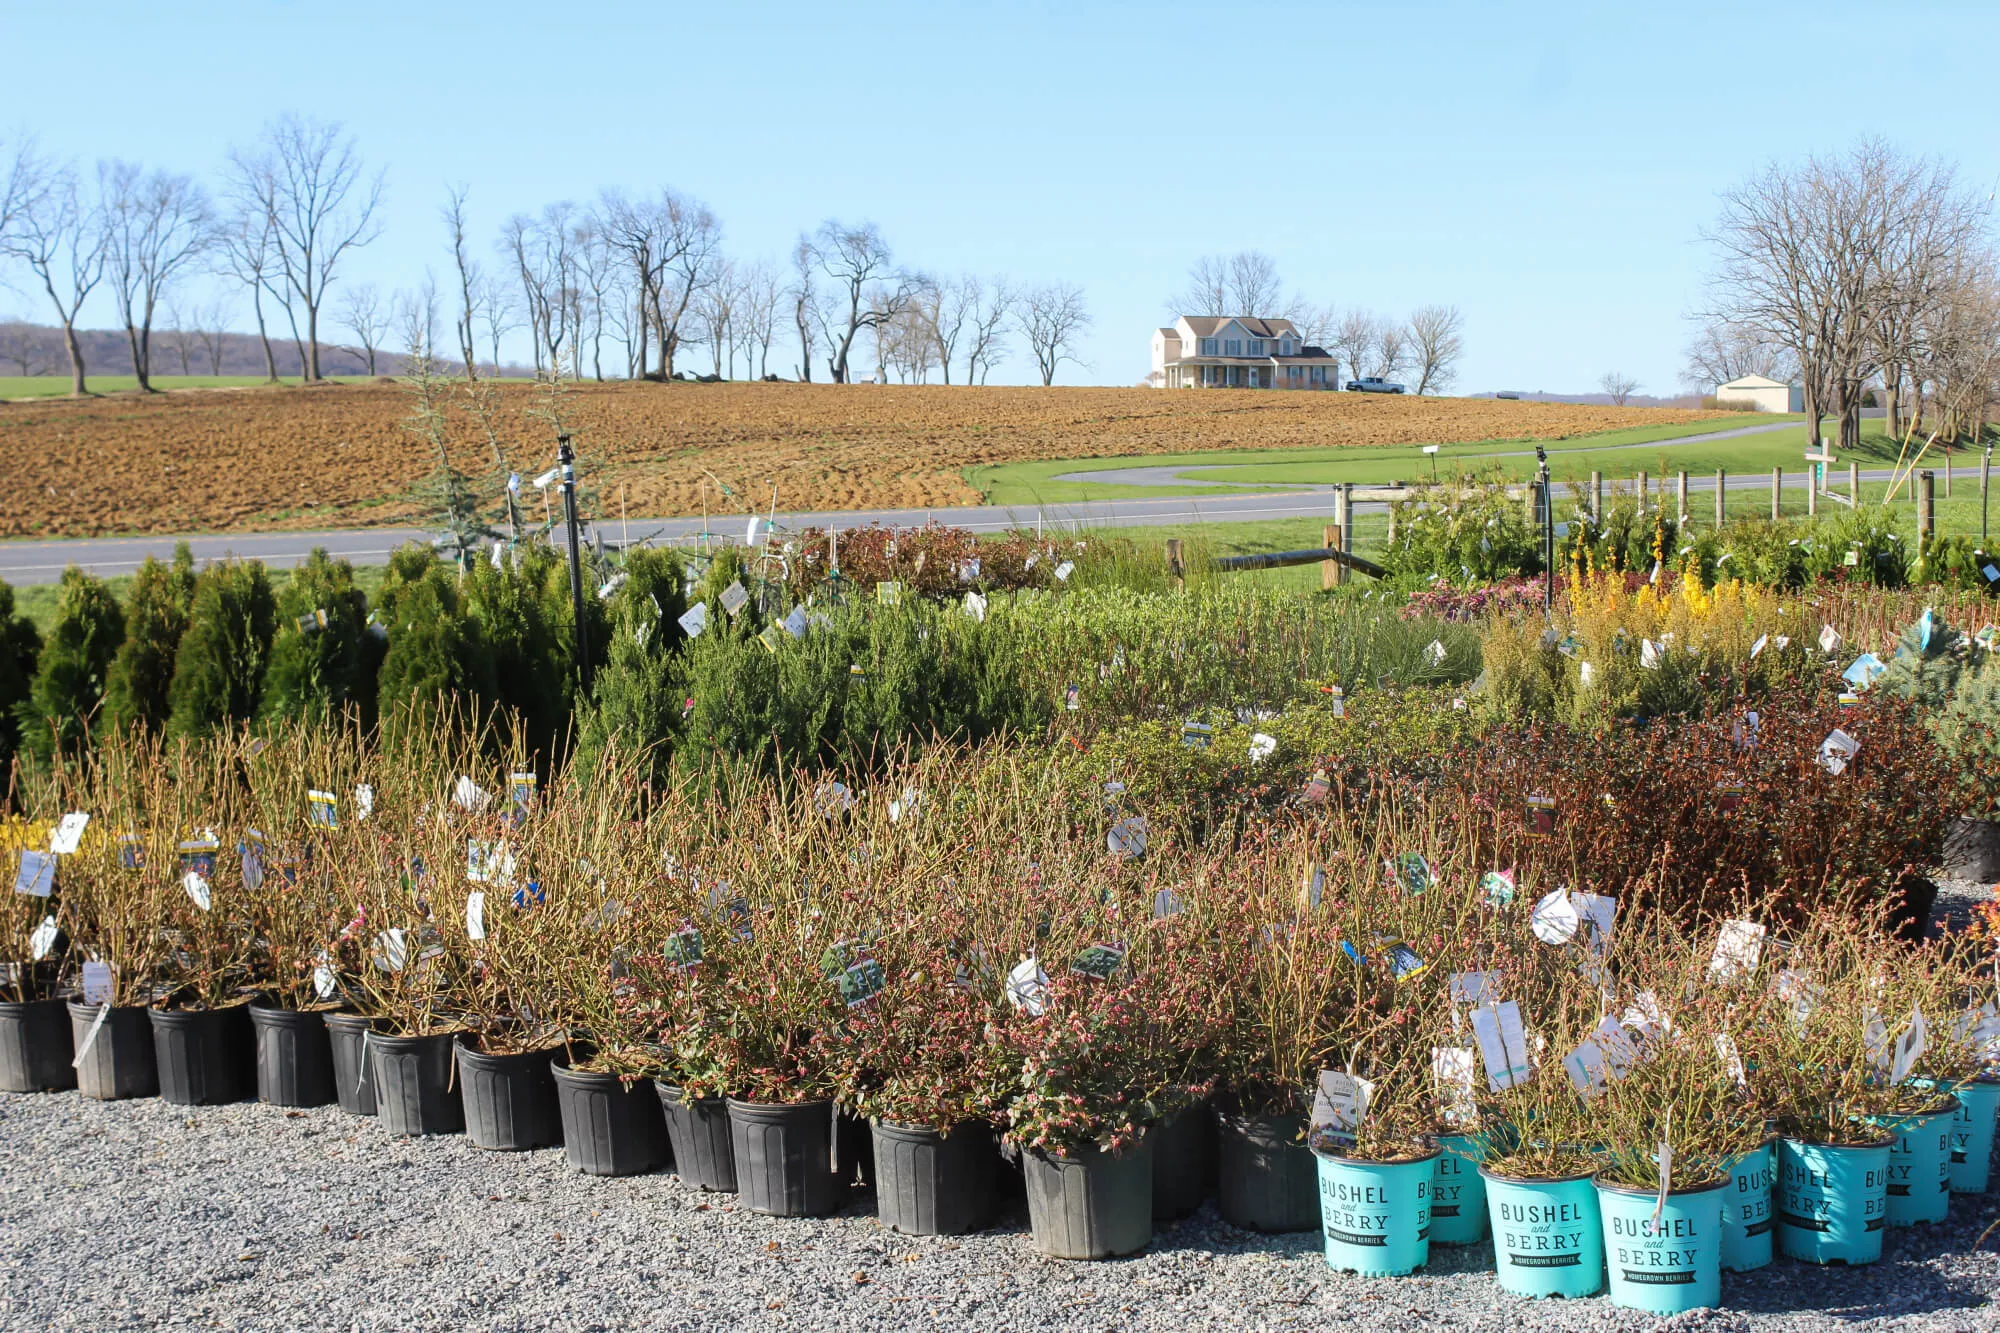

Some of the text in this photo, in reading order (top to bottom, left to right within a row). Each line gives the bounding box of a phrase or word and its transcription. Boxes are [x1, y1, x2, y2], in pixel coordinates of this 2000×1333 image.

[1321, 1176, 1388, 1204] BUSHEL
[1340, 1202, 1357, 1212] and
[1501, 1203, 1582, 1223] BUSHEL
[1324, 1205, 1388, 1230] BERRY
[1531, 1224, 1551, 1233] and
[1613, 1217, 1697, 1238] BUSHEL
[1505, 1232, 1582, 1250] BERRY
[1644, 1239, 1664, 1248] and
[1618, 1248, 1697, 1266] BERRY
